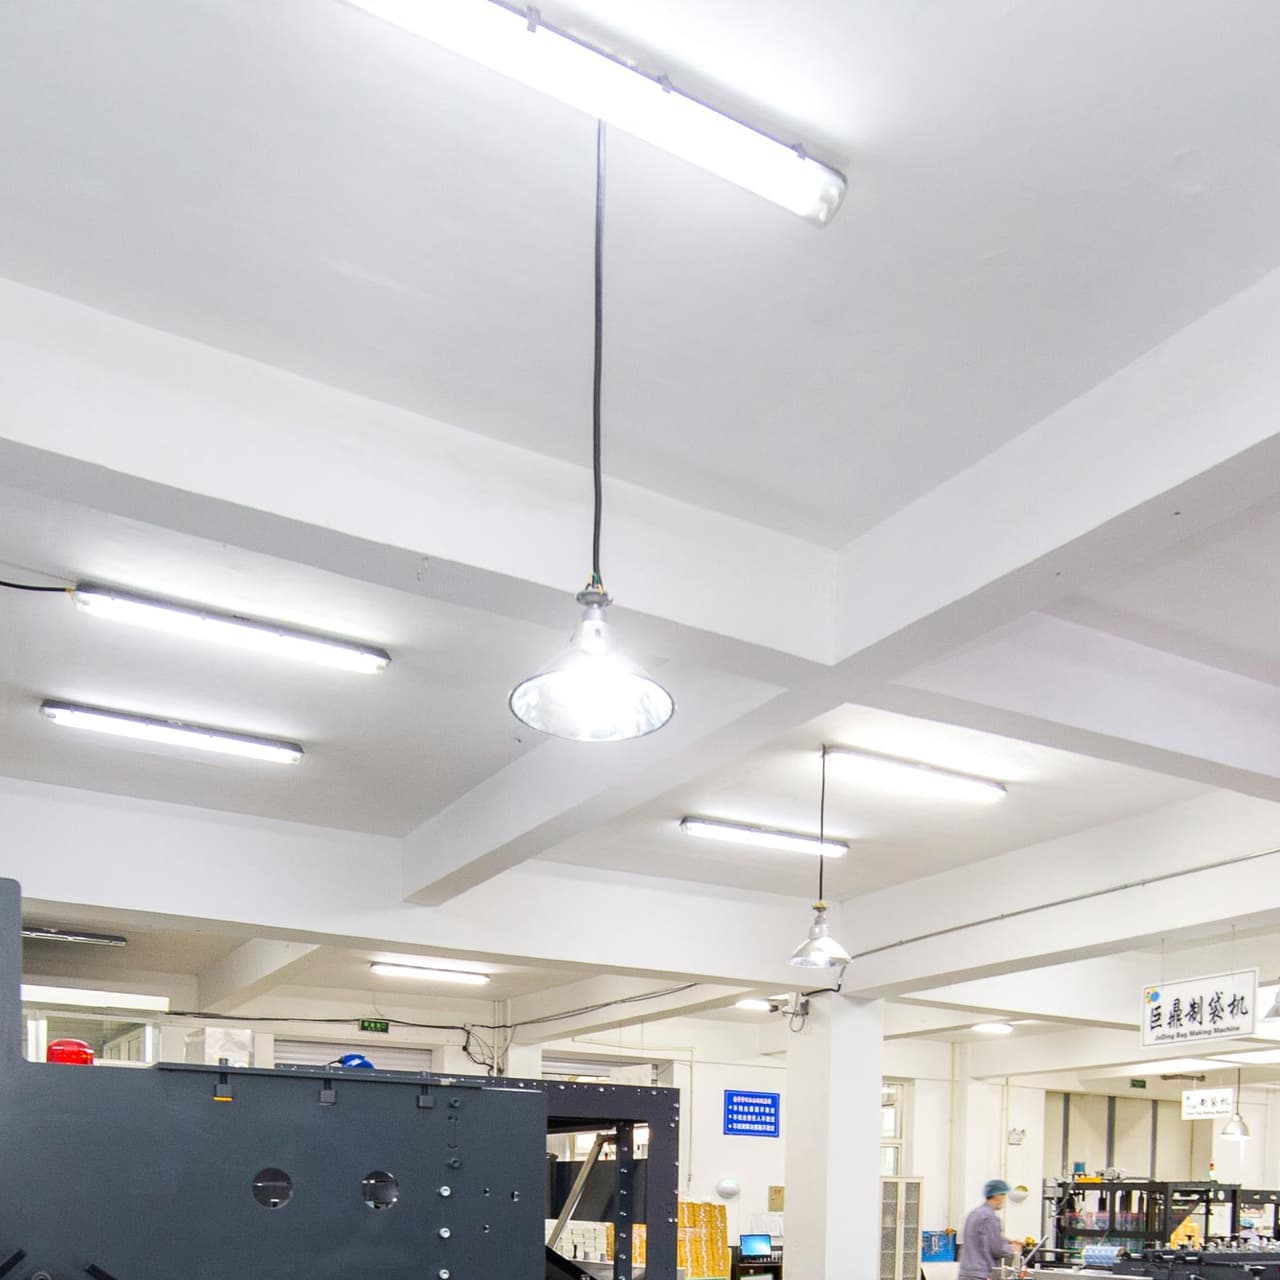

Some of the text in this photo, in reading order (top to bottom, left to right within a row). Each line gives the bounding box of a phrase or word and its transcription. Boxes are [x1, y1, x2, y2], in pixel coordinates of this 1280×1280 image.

[1150, 991, 1249, 1031] 巨鼎制袋机
[1213, 1025, 1240, 1033] Machine
